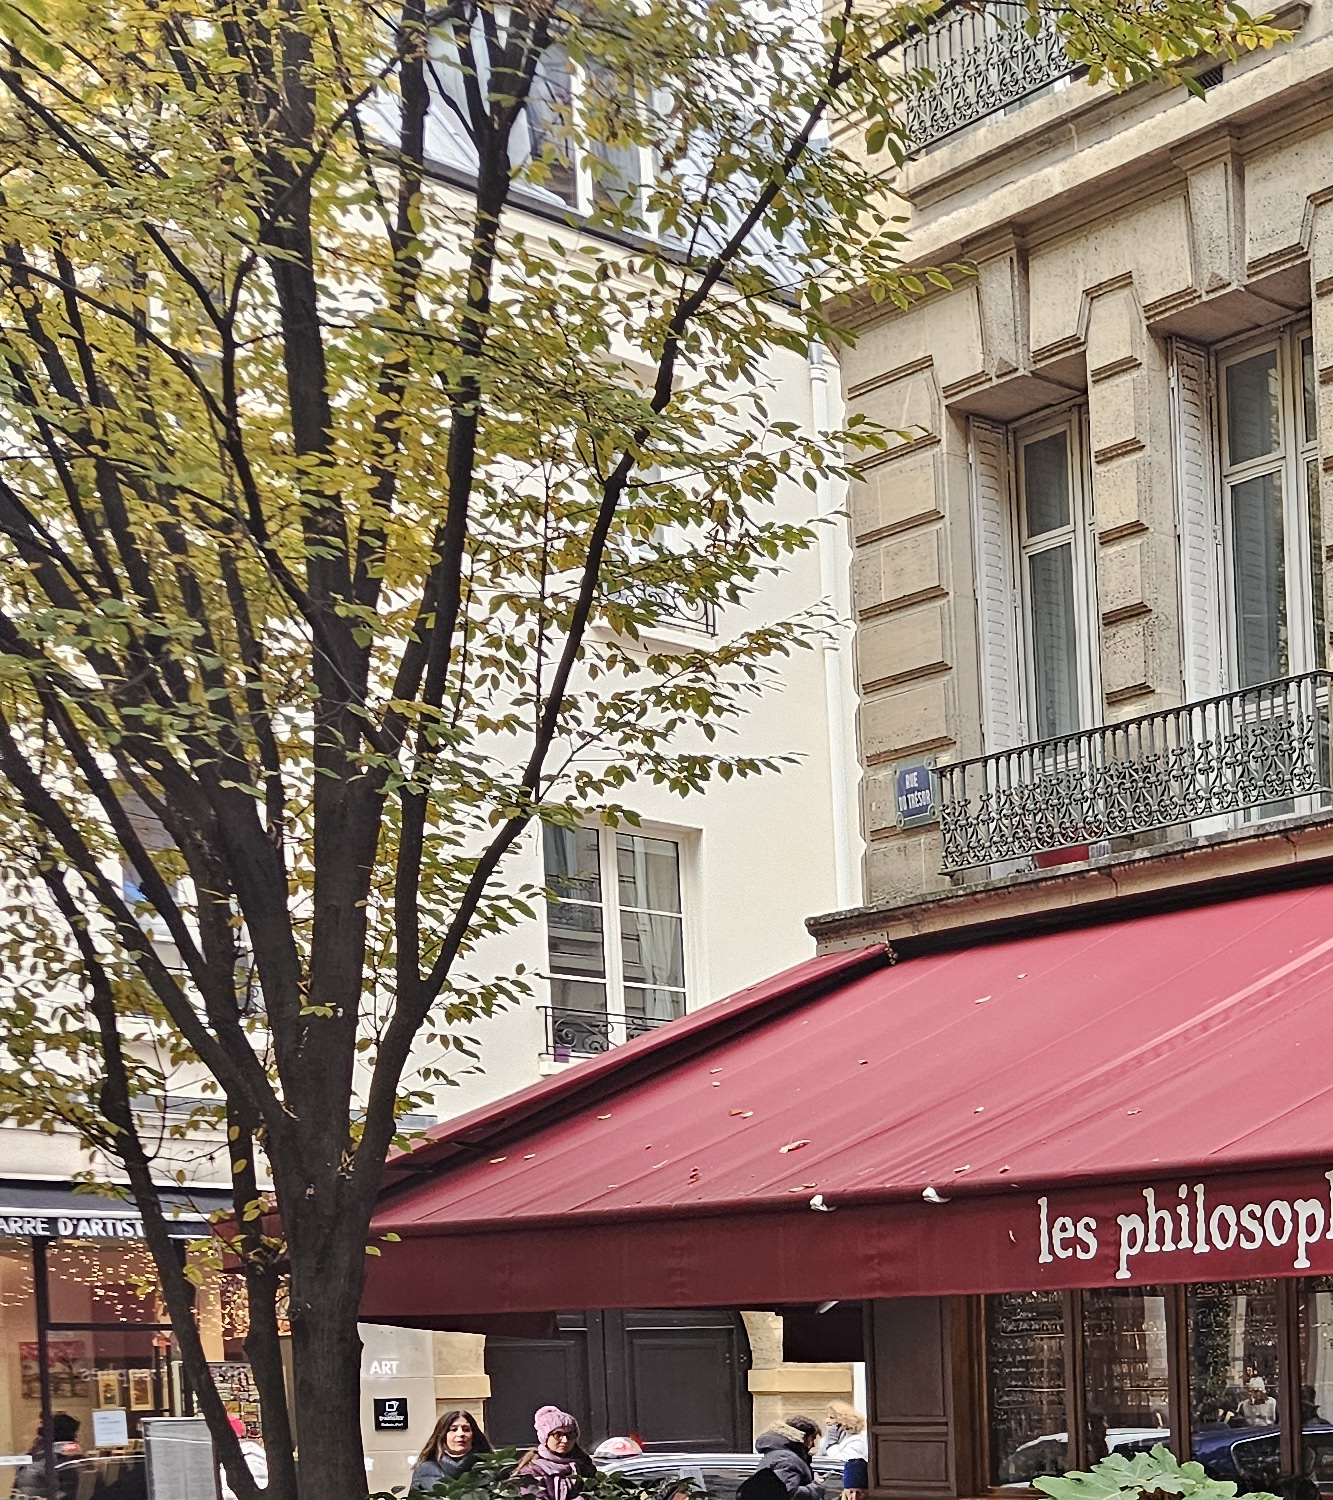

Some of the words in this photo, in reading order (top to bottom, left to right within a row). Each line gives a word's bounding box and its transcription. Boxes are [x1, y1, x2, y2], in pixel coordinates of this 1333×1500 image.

[905, 771, 919, 790] RUE
[898, 795, 908, 811] DU
[907, 789, 932, 809] TRÉSOR
[1037, 1196, 1098, 1264] les
[369, 1360, 401, 1375] ART
